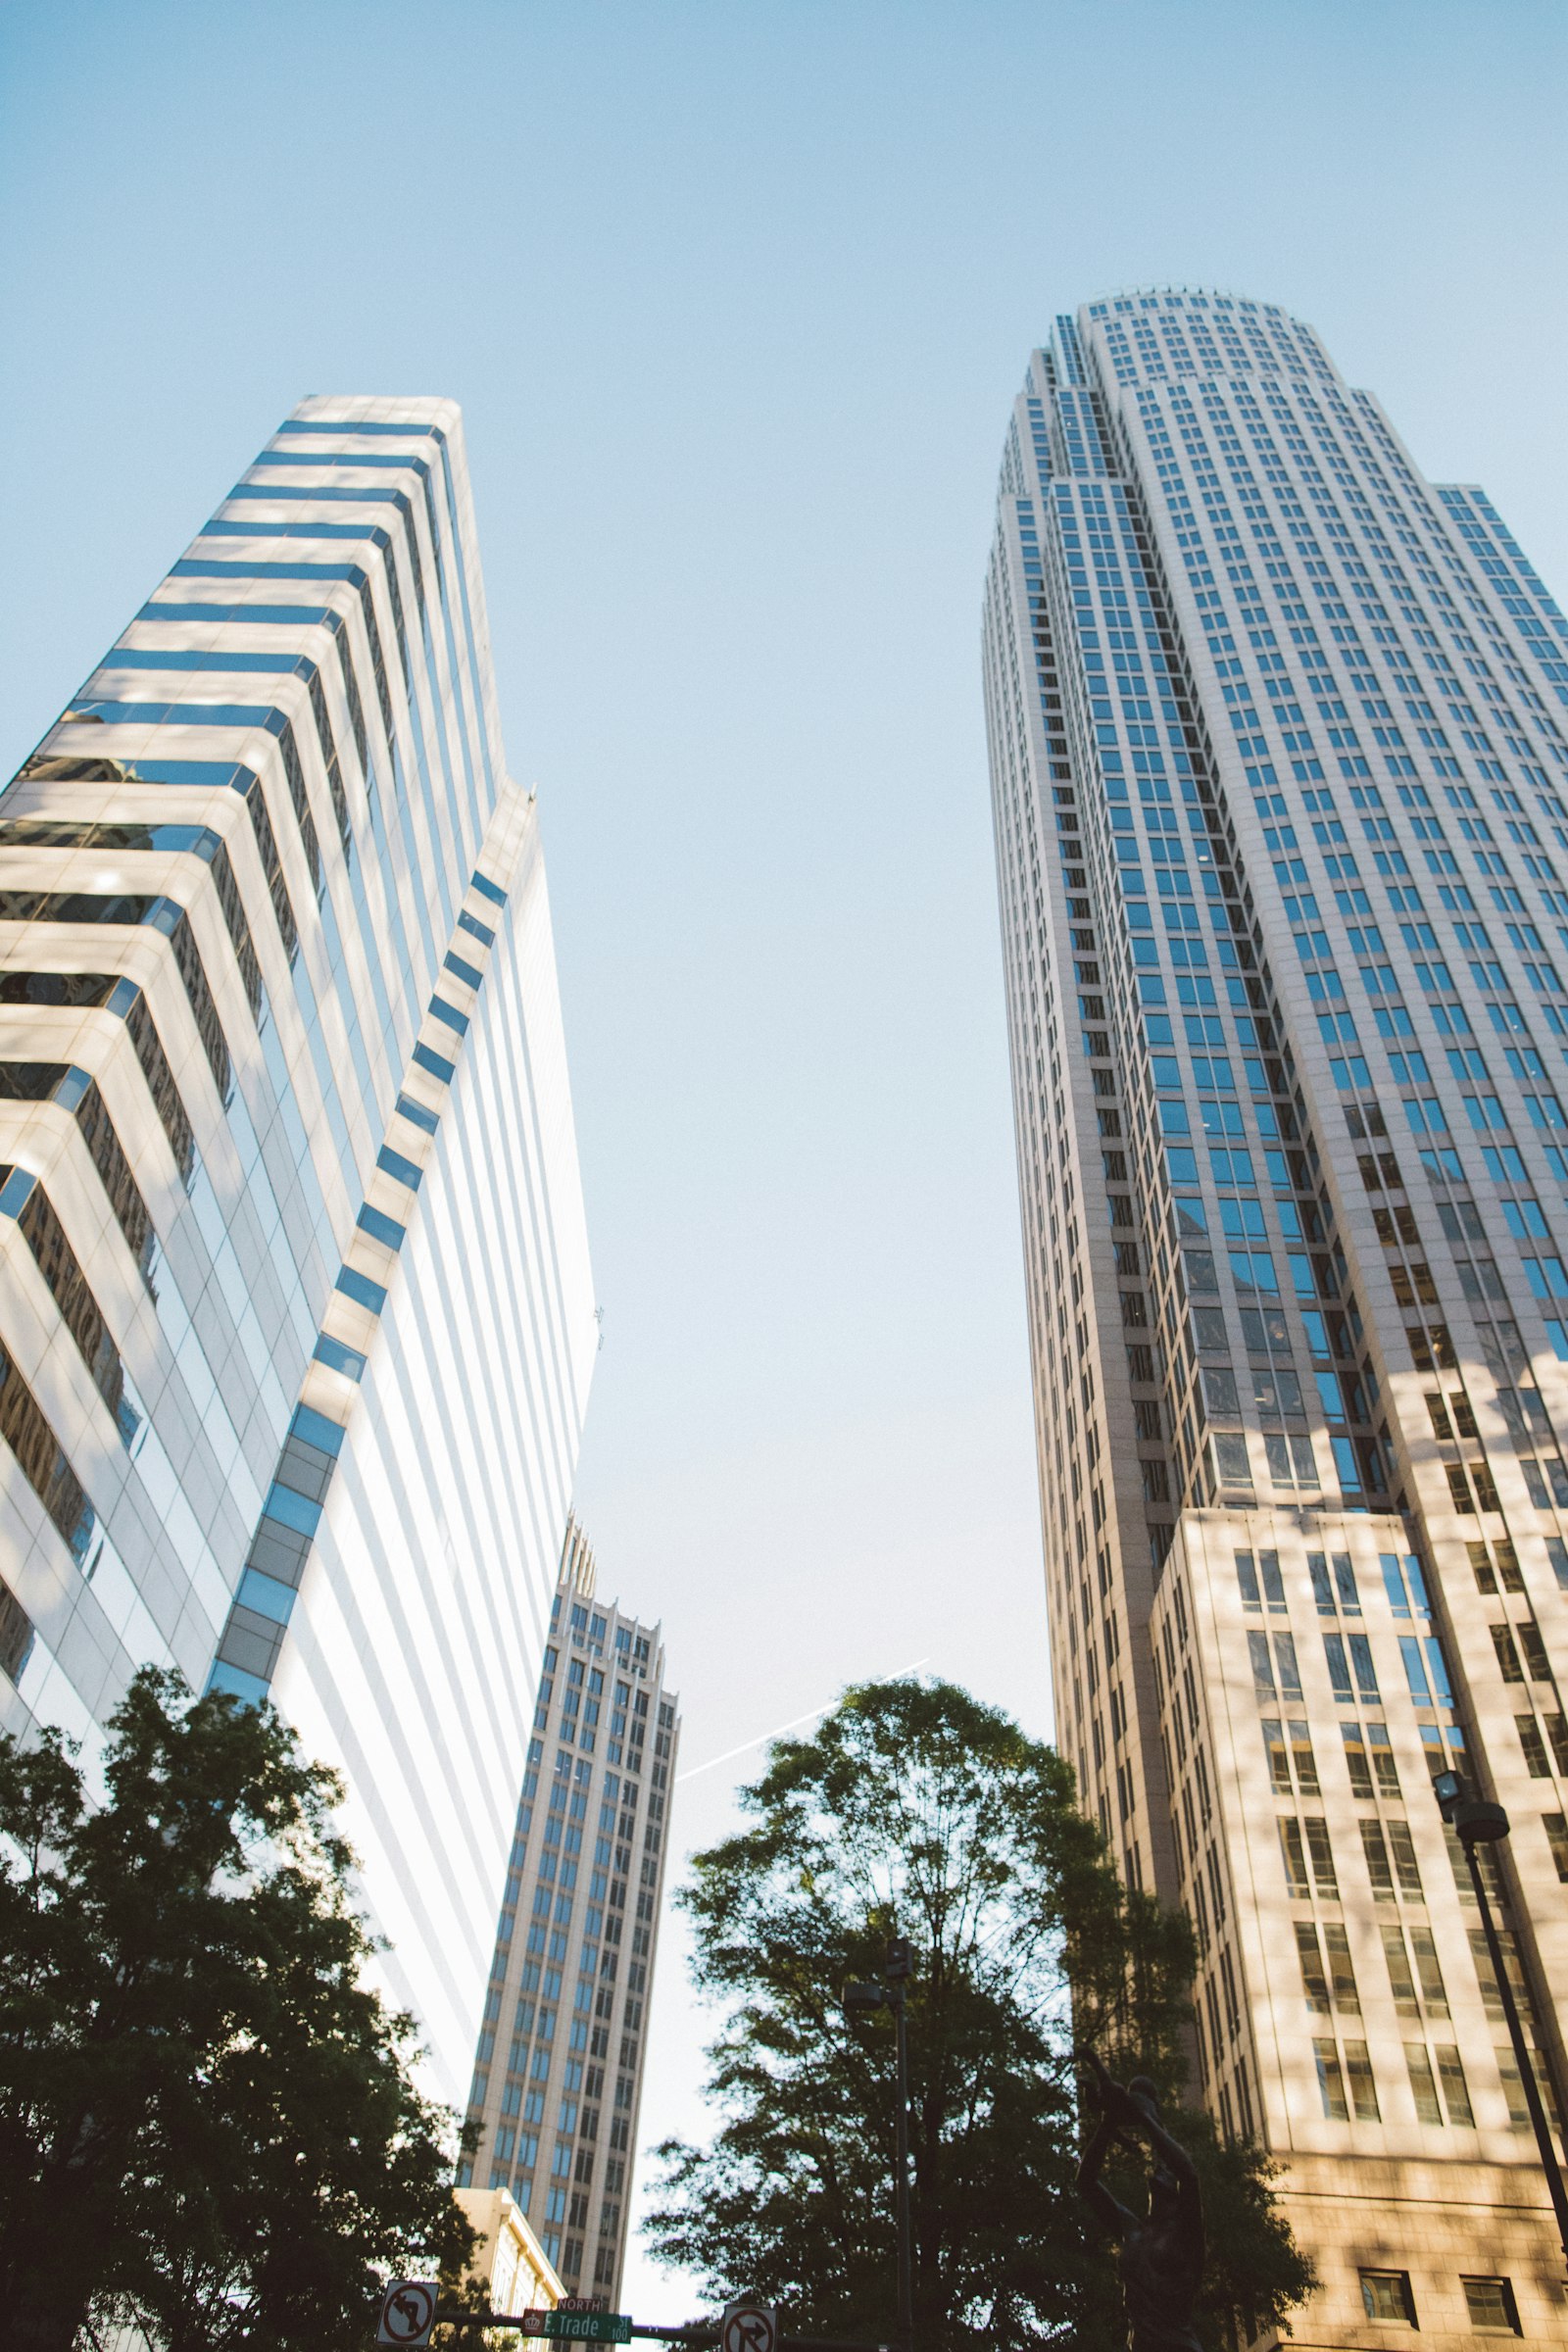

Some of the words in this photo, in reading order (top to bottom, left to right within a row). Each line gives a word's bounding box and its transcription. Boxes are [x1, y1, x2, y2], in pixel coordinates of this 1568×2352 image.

[559, 2299, 600, 2312] NORTH
[544, 2313, 555, 2332] E.
[560, 2315, 599, 2336] Trade
[612, 2328, 628, 2340] 100
